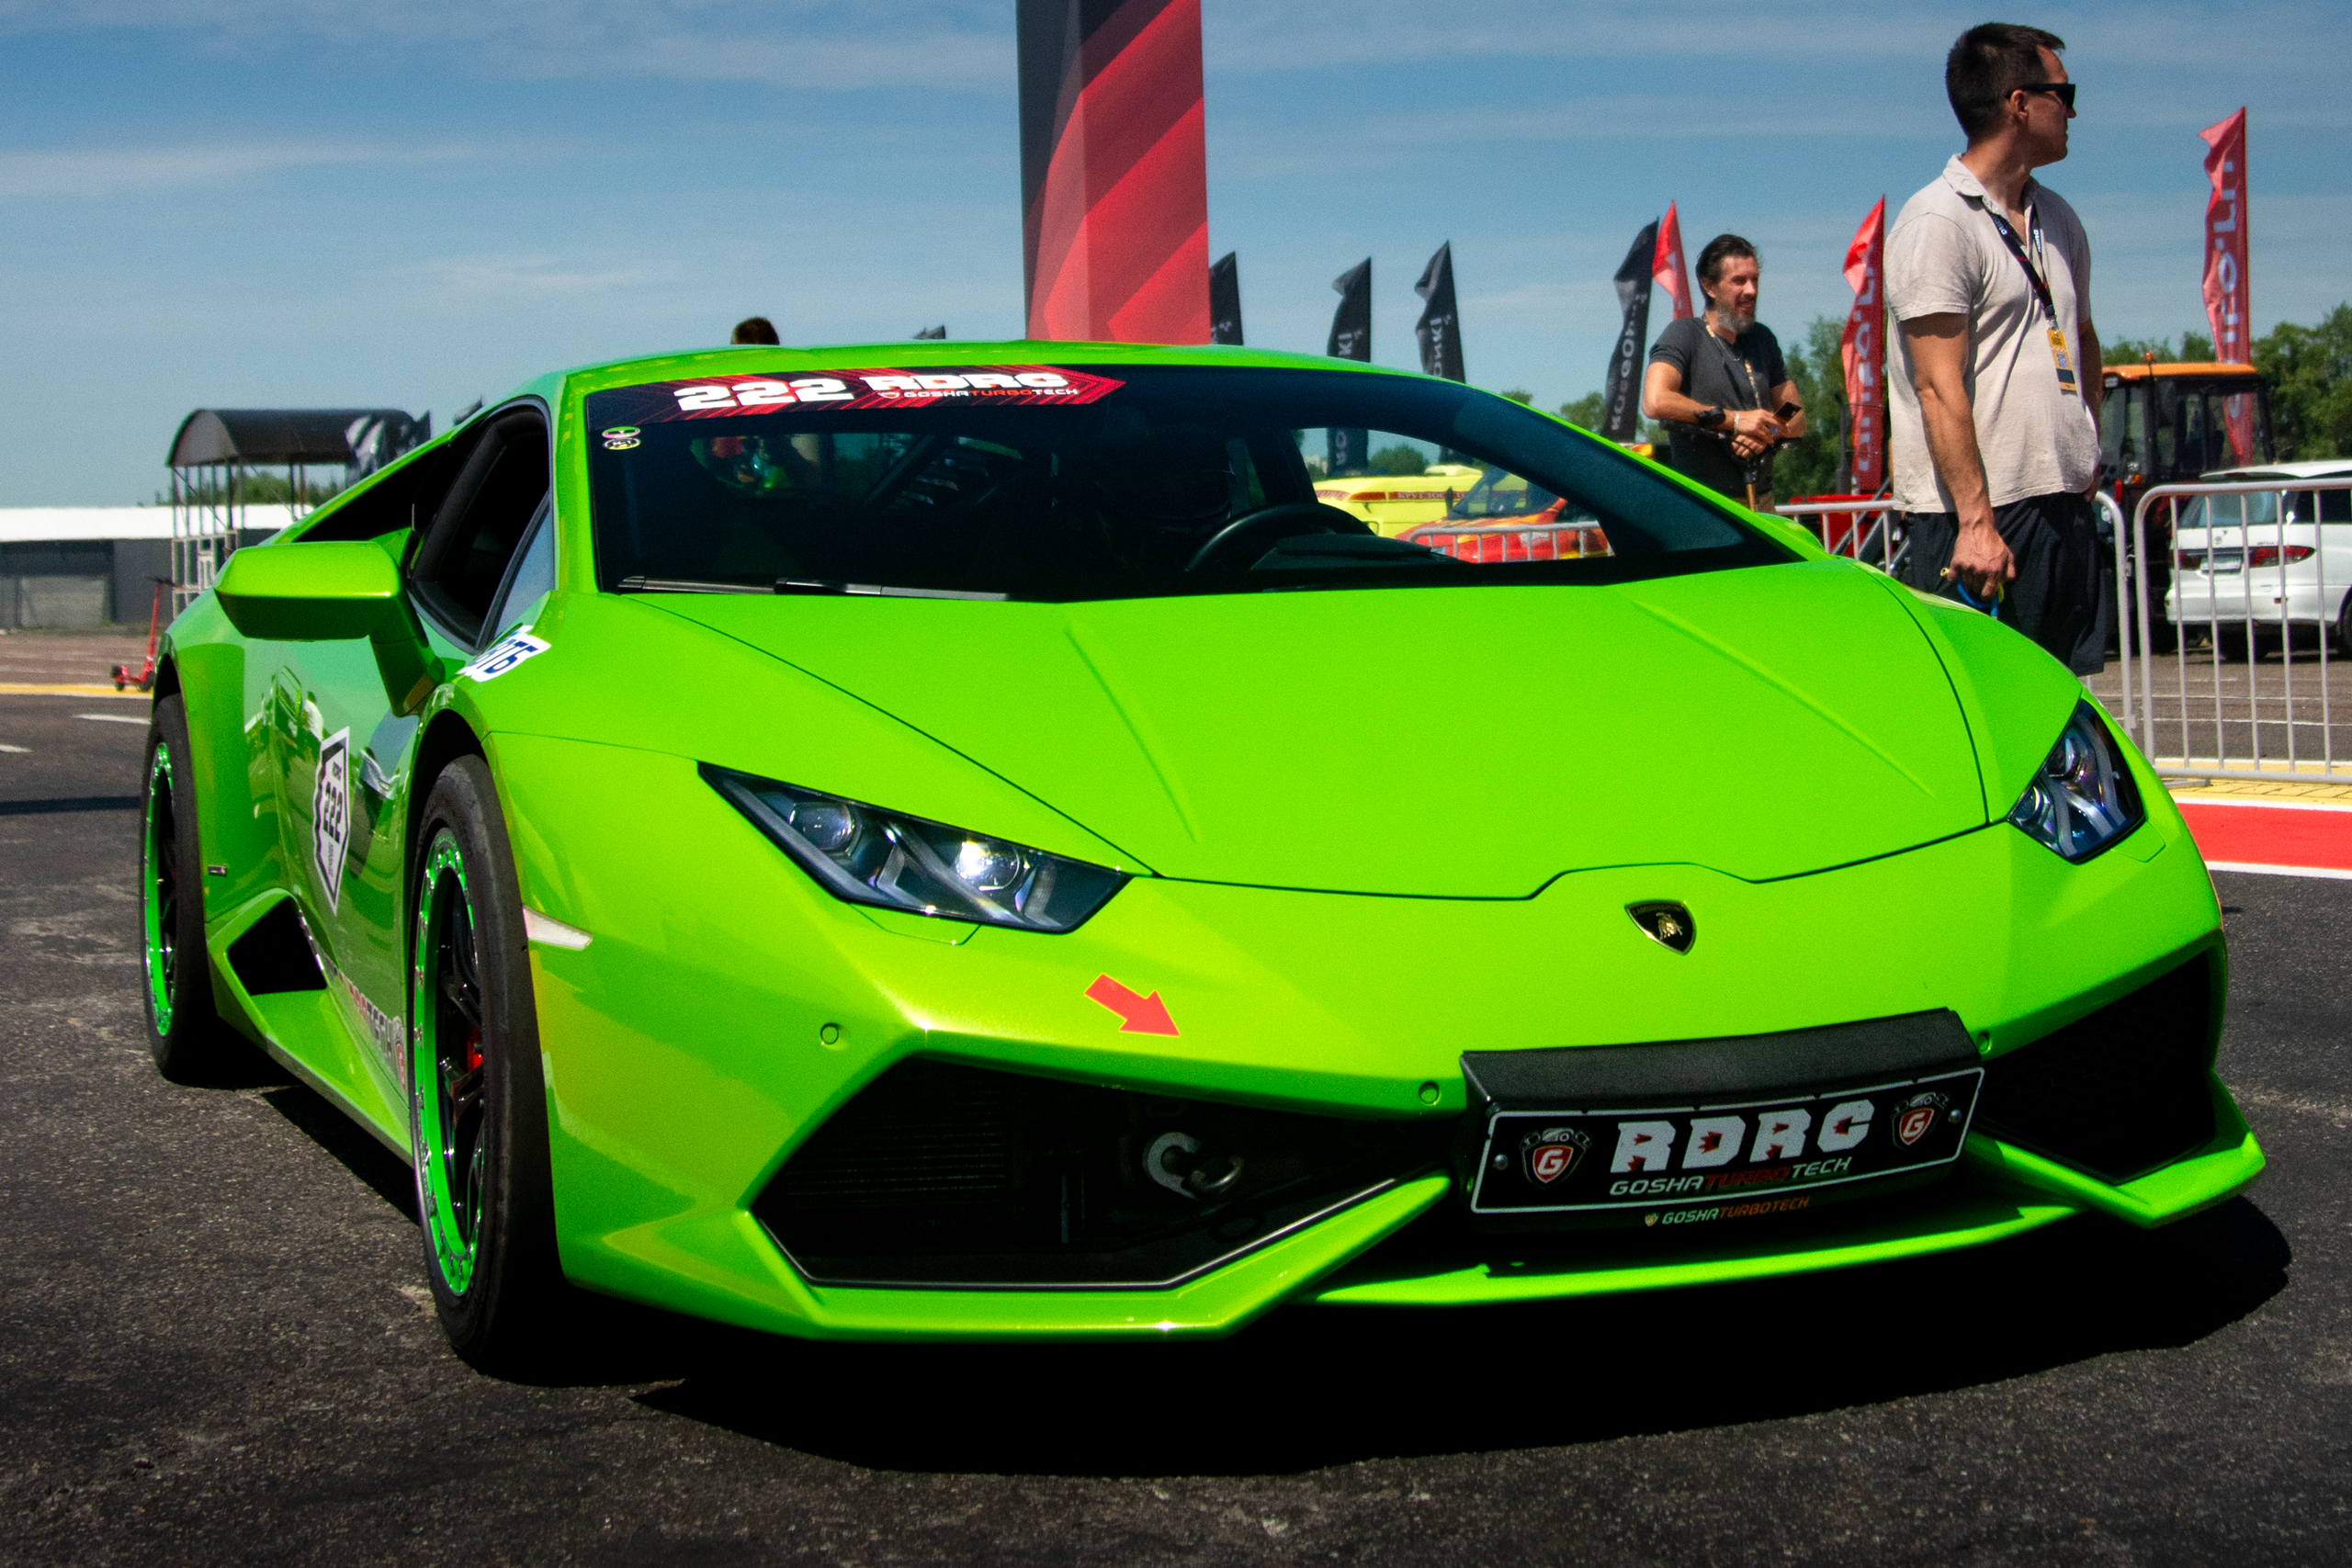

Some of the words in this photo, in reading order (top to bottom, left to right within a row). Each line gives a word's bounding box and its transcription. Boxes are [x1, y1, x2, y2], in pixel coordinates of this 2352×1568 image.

[673, 378, 855, 412] 222
[858, 372, 1069, 391] RDRC
[903, 388, 1079, 399] GOSHATURBOTECH
[322, 781, 344, 844] 222
[1610, 1100, 1876, 1174] RDRC
[1903, 1111, 1927, 1138] G
[1537, 1149, 1564, 1175] G
[1610, 1156, 1852, 1195] GOSHATURBOTECH
[1661, 1196, 1810, 1225] GOSHATURBOTECH
